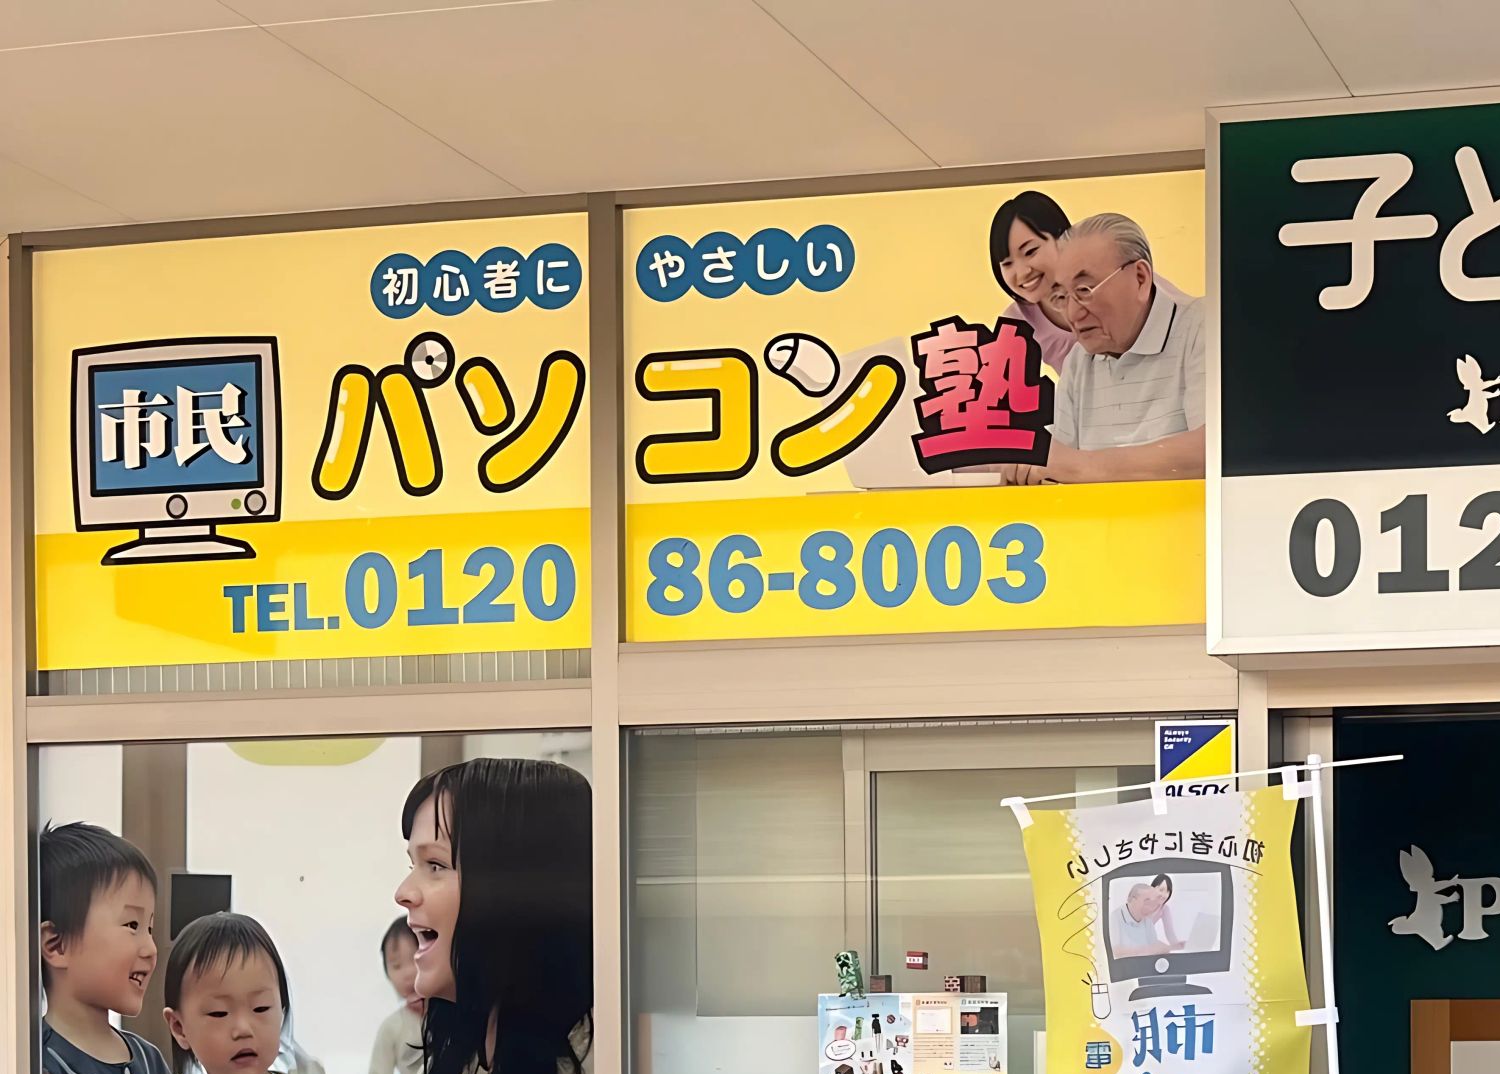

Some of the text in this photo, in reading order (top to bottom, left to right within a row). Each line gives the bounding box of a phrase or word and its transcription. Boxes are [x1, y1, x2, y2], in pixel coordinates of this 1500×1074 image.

[381, 240, 843, 306] 初心者に やさしい
[97, 382, 248, 470] 市民
[646, 523, 1048, 616] 86-8003
